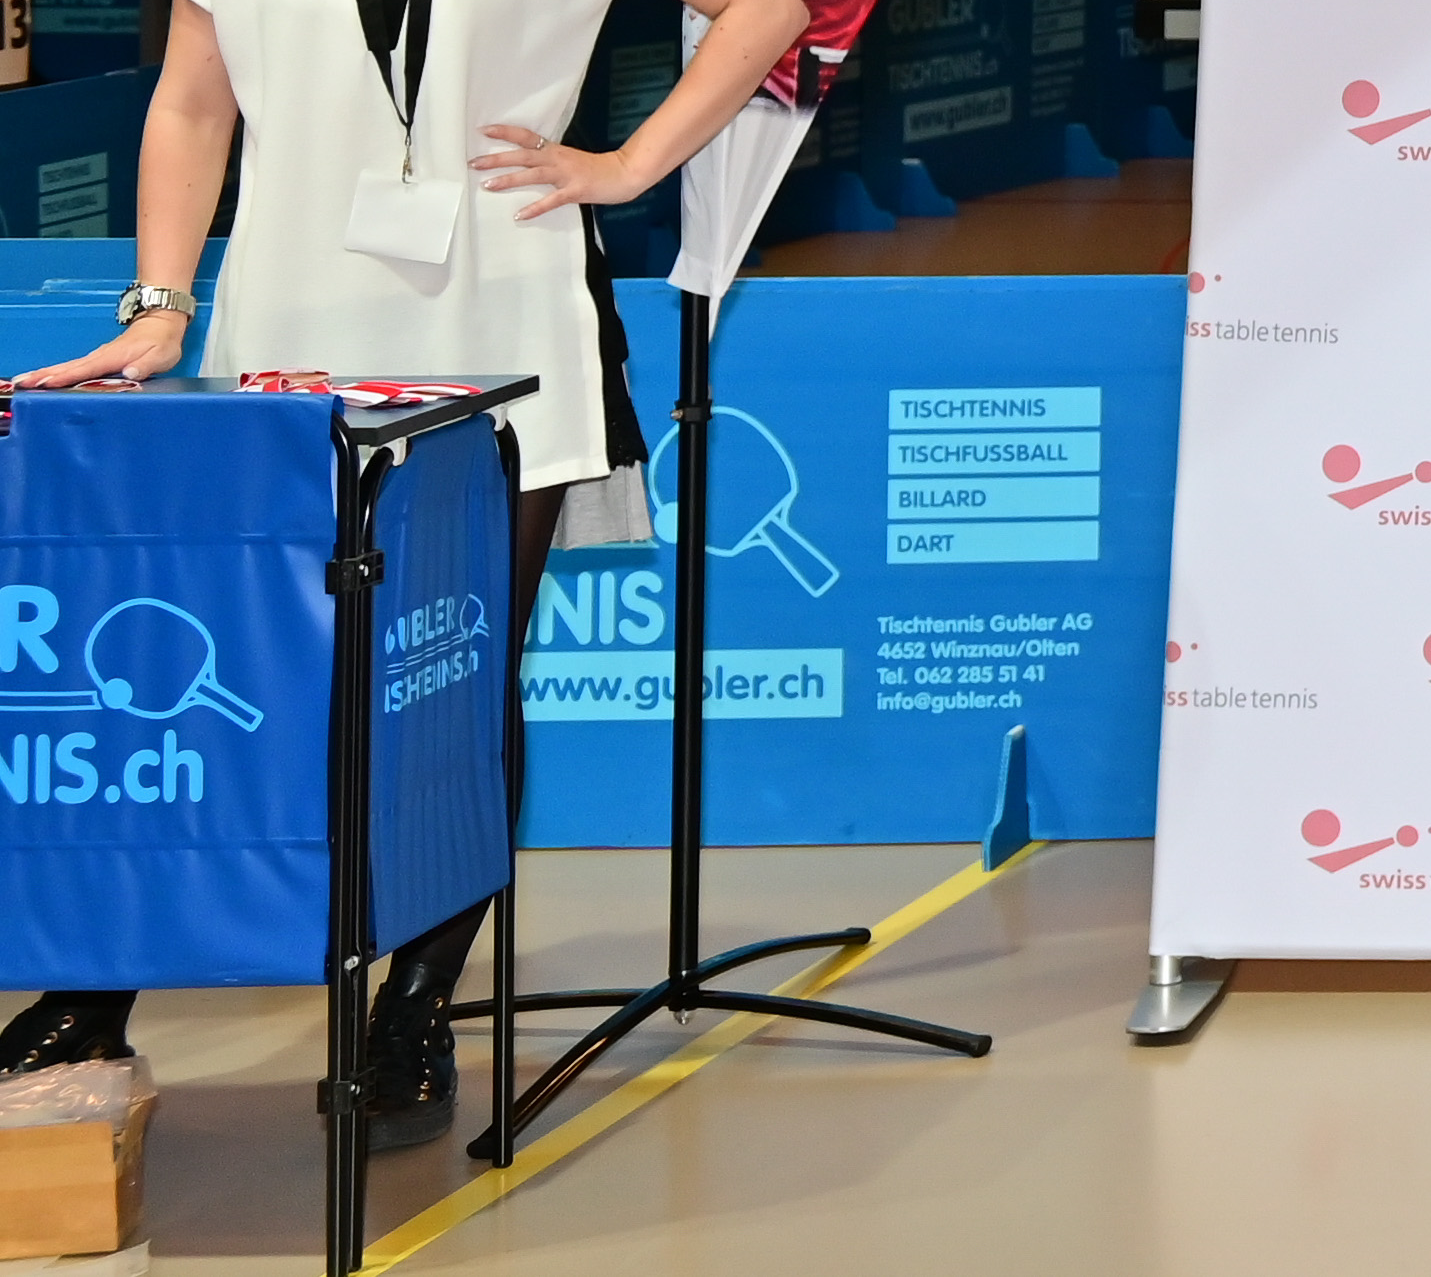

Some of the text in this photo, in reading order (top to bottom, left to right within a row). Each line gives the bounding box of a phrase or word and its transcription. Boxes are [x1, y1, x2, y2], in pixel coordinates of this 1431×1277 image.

[900, 399, 1047, 419] TISCHTENNIS
[898, 443, 1068, 464] TISCHFUSSBALL
[898, 488, 987, 509] BILLARD
[897, 533, 955, 554] DART
[877, 613, 1093, 634] Tischtennis Gubler AG
[877, 638, 1080, 660] 4652 Winznau/Olten
[877, 664, 1046, 685] Tel. 062 285 51 41
[877, 689, 1022, 713] info@gubler.ch
